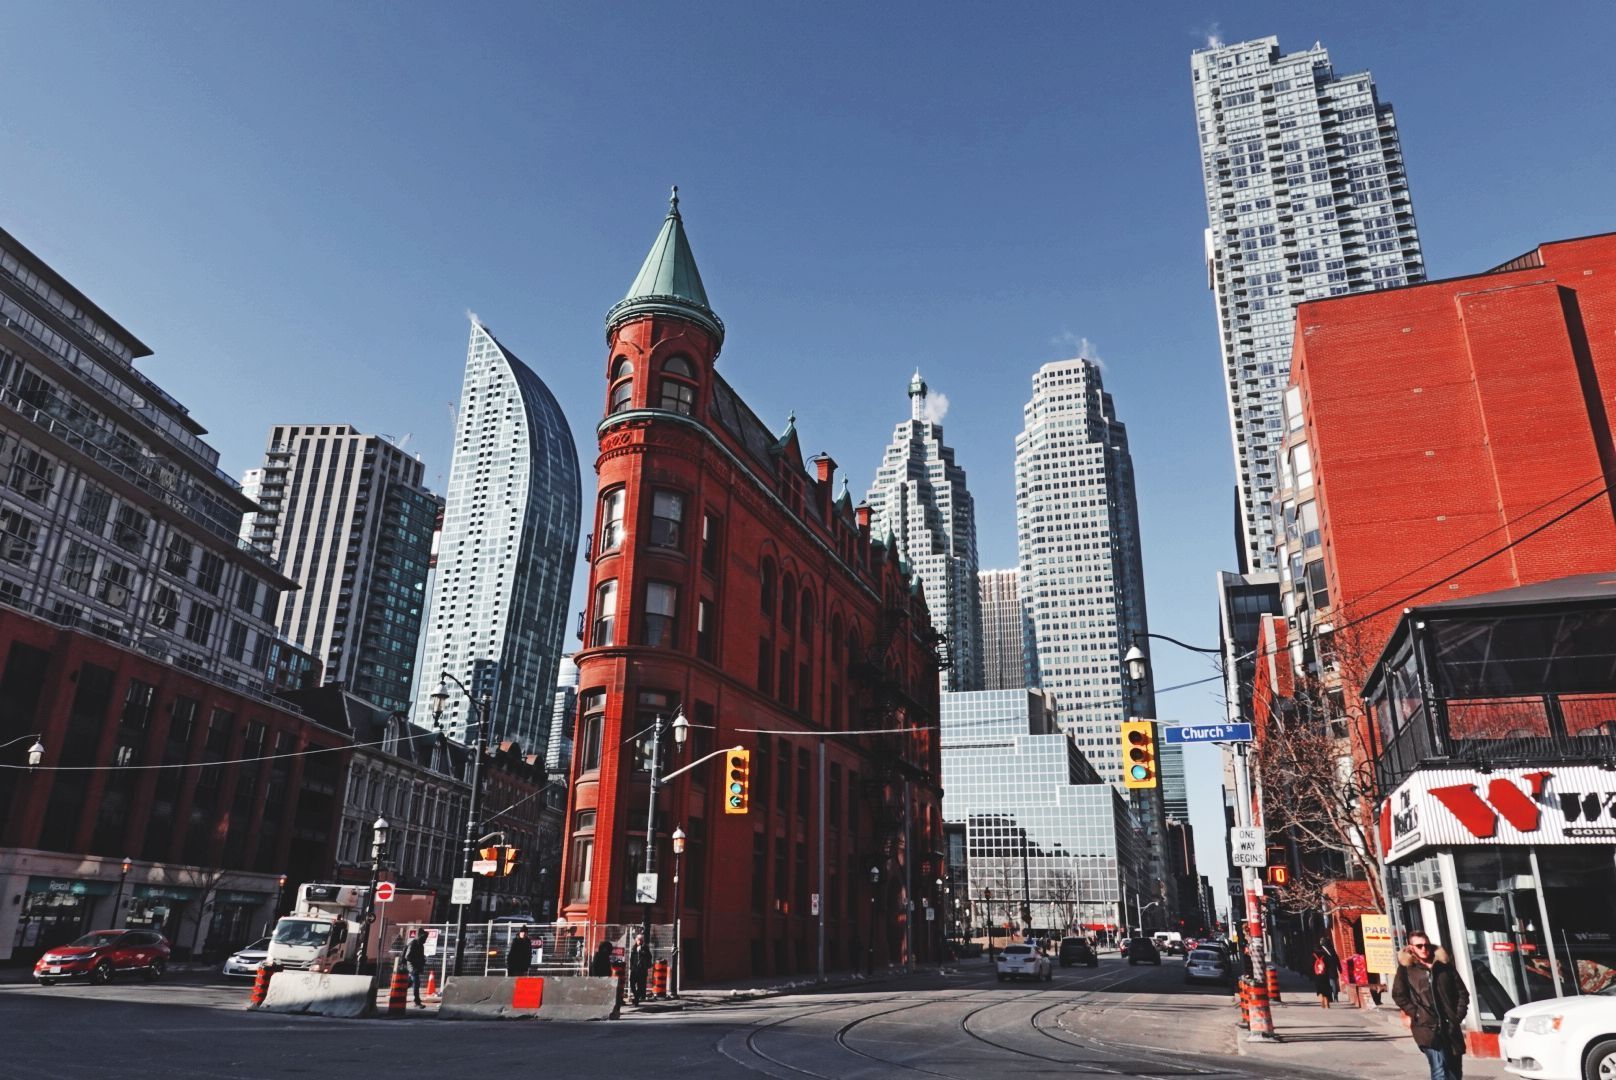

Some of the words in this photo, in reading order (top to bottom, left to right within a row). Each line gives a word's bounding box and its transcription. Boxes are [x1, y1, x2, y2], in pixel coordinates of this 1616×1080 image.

[1181, 726, 1224, 739] Church
[1239, 831, 1255, 839] ONE
[1240, 842, 1255, 850] WAY
[1234, 853, 1263, 863] BEGINS
[1229, 885, 1241, 894] 40
[1365, 926, 1389, 934] PAR
